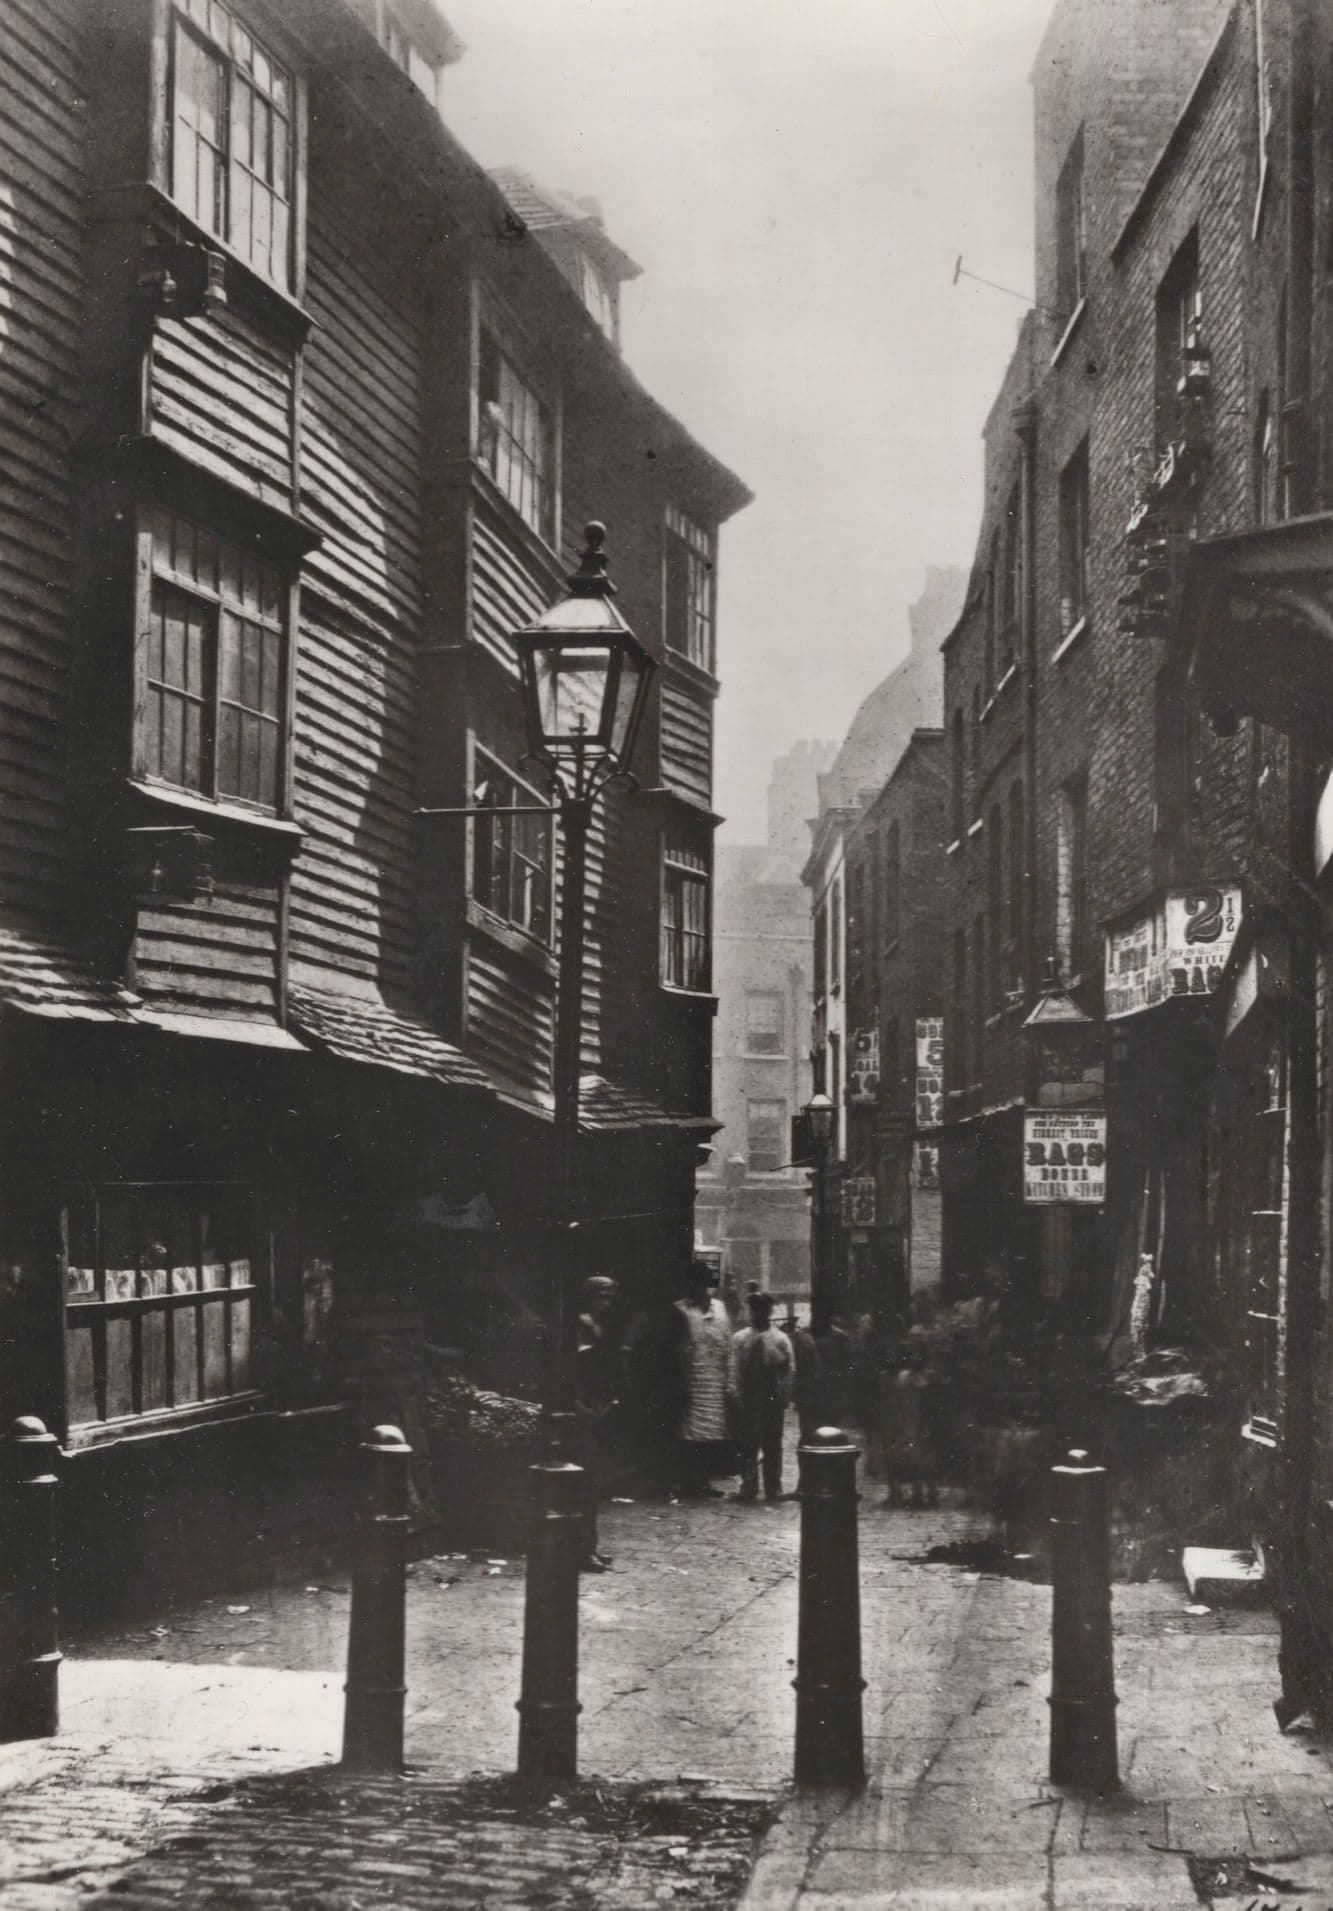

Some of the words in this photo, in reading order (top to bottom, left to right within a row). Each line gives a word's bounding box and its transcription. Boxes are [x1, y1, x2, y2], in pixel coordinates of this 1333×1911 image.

[1182, 888, 1223, 945] 2
[1184, 955, 1224, 965] WHITE
[1024, 1142, 1106, 1167] RAGS
[1041, 1168, 1088, 1181] BONES
